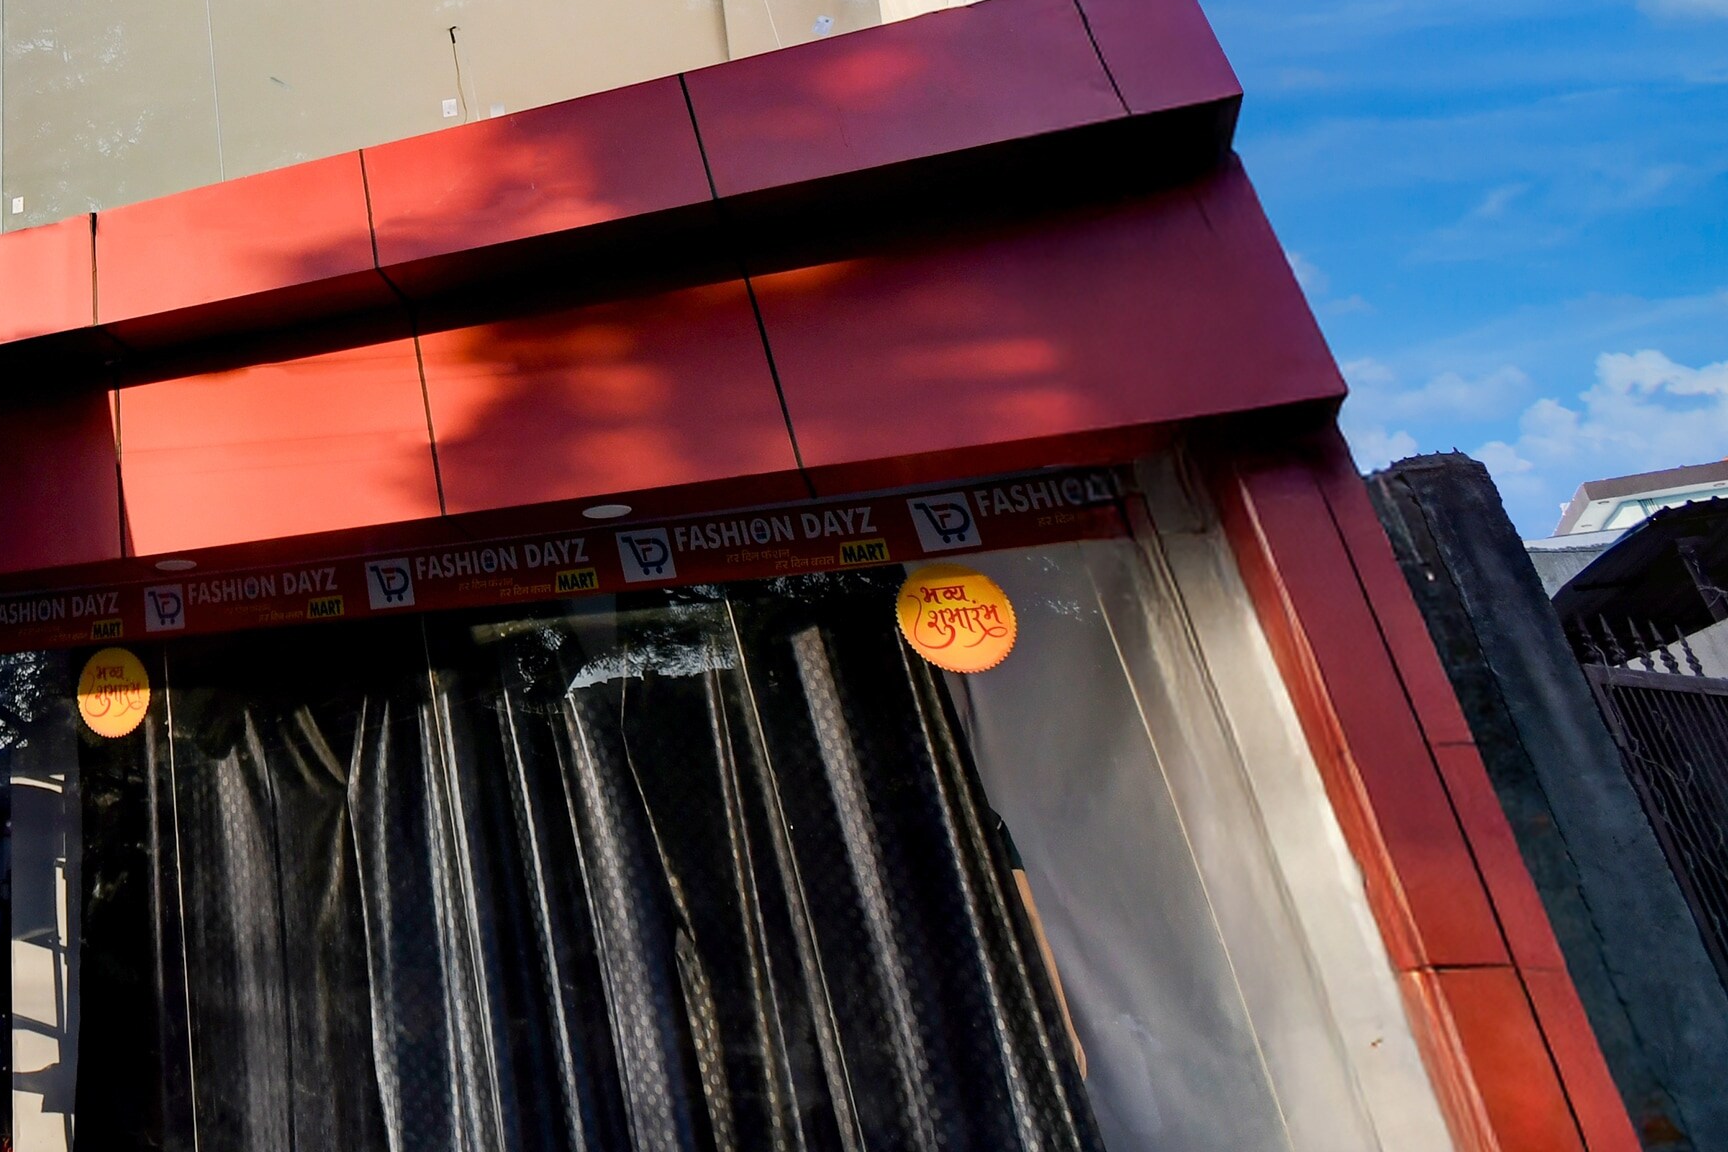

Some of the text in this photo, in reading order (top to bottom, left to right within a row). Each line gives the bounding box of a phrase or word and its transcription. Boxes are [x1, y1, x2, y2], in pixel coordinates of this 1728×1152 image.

[673, 507, 877, 552] FASHION DAYZ
[415, 538, 589, 580] FASHION DAYZ
[842, 542, 885, 562] MART
[188, 567, 339, 605] FASHION DAYZ
[558, 571, 596, 591] MART
[72, 592, 119, 618] DAYZ
[310, 599, 341, 616] MART
[93, 622, 120, 638] MART
